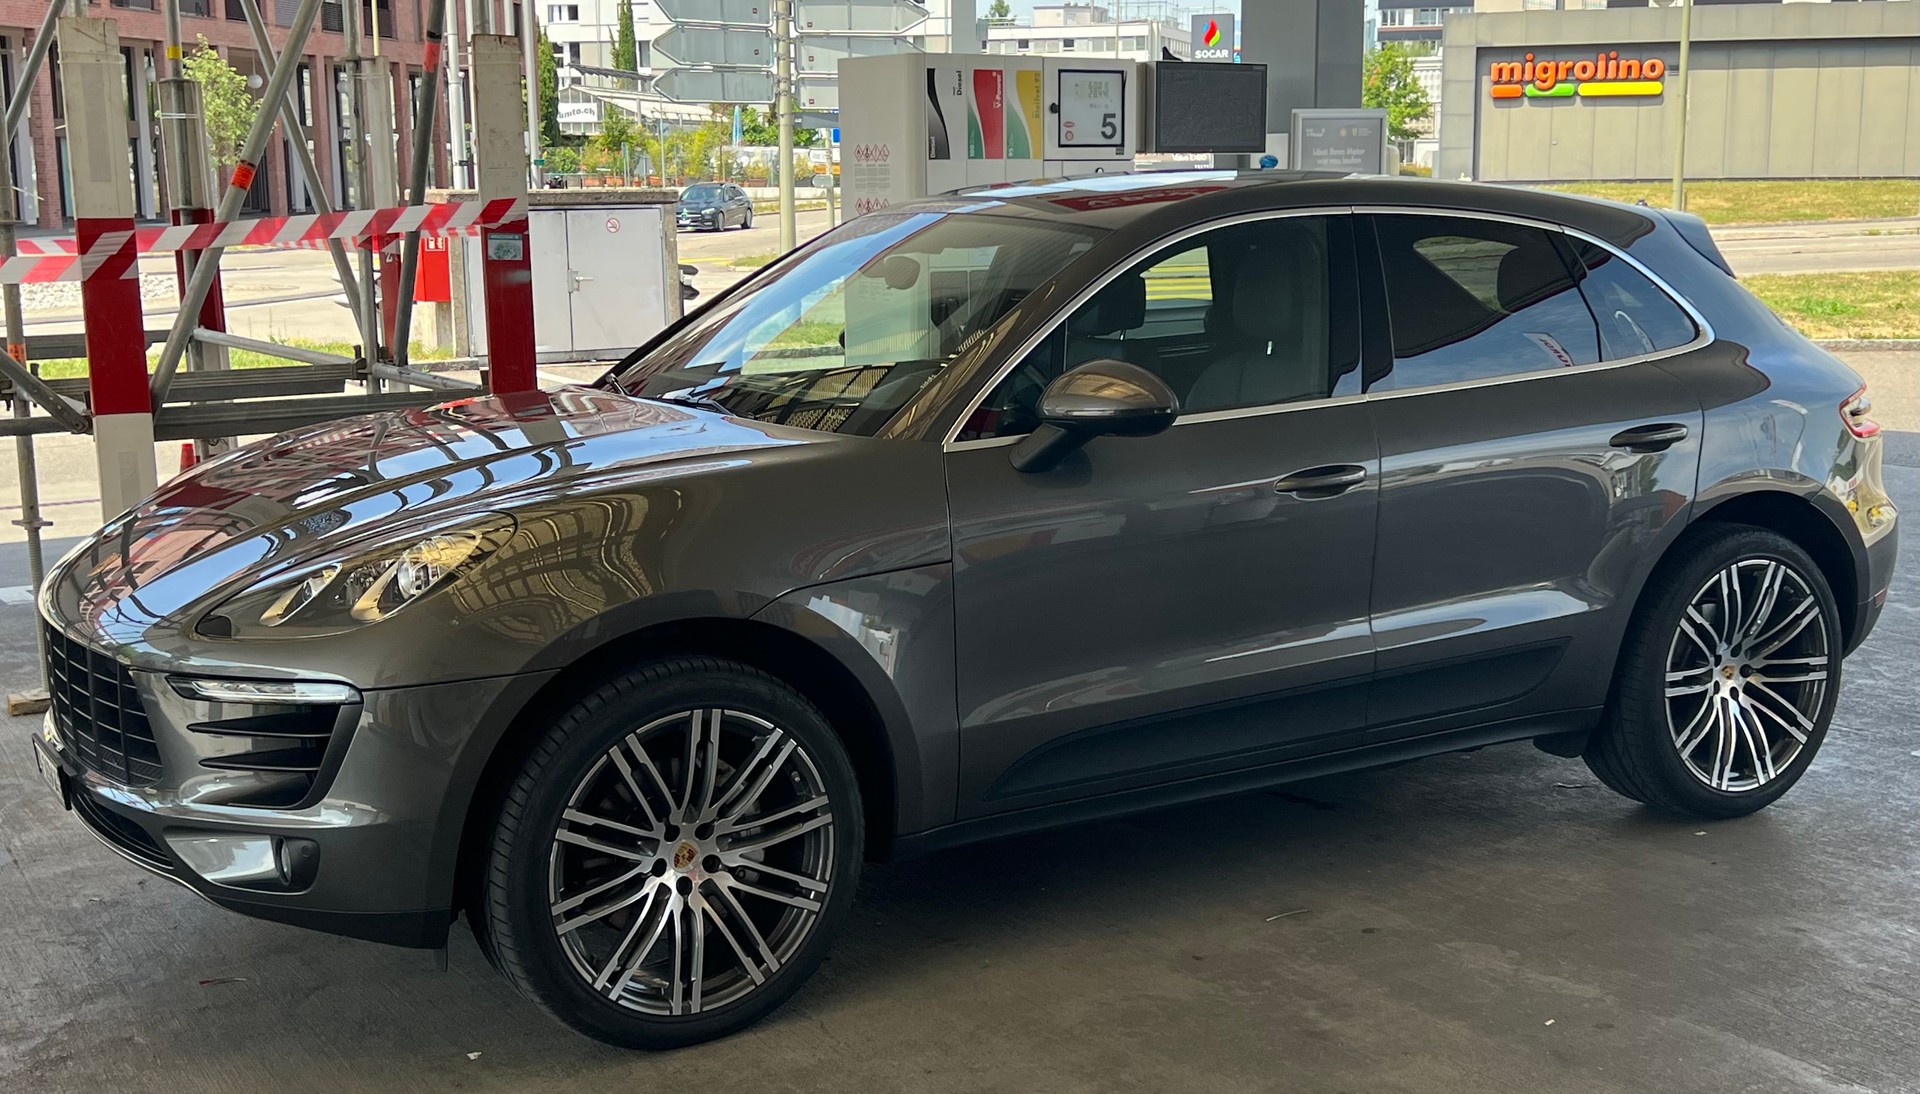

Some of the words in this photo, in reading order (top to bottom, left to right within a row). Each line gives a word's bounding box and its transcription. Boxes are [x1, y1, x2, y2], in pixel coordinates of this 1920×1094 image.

[1194, 49, 1229, 59] SOCAR
[1490, 51, 1665, 90] migrolino
[1101, 113, 1117, 140] 5
